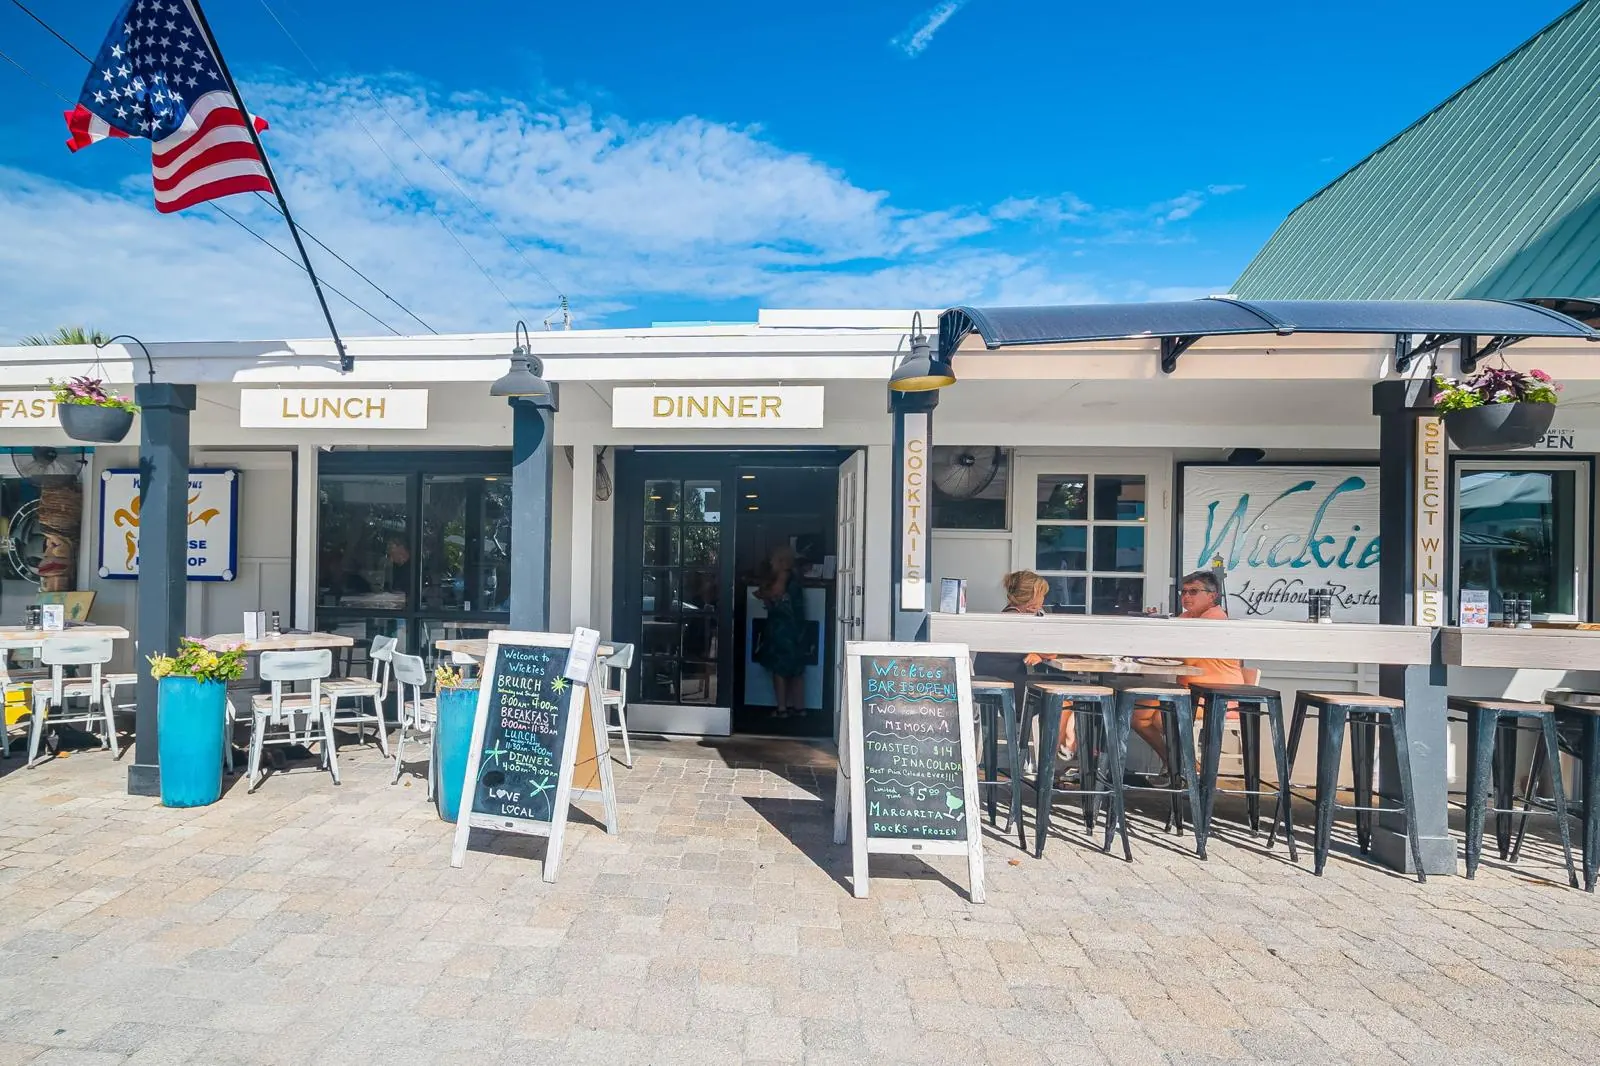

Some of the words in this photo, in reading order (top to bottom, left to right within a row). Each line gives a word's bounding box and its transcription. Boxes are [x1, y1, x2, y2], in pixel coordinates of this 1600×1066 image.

[282, 396, 386, 419] LUNCH
[652, 395, 783, 418] DINNER
[1532, 435, 1574, 449] PEN
[1422, 422, 1440, 526] SELECT
[907, 439, 923, 585] COCKTAILS
[1197, 475, 1381, 571] Wickie
[188, 540, 207, 550] SE
[187, 557, 207, 567] OP
[1420, 537, 1440, 624] WINES
[1229, 578, 1309, 616] Lighthou
[1326, 580, 1380, 609] Resta
[504, 650, 539, 661] Welcome
[541, 653, 550, 662] to
[508, 662, 545, 676] Wickies
[871, 659, 944, 679] Wickies
[497, 674, 542, 692] BRUNCH
[868, 679, 897, 697] BAR
[500, 706, 559, 726] BREAKFAST
[868, 703, 896, 715] TWO
[919, 706, 945, 718] ONE
[504, 729, 536, 742] LUNCH
[885, 720, 935, 733] MIMOSA
[866, 740, 919, 756] TOASTED
[933, 745, 953, 757] $14
[509, 751, 553, 767] DINNER
